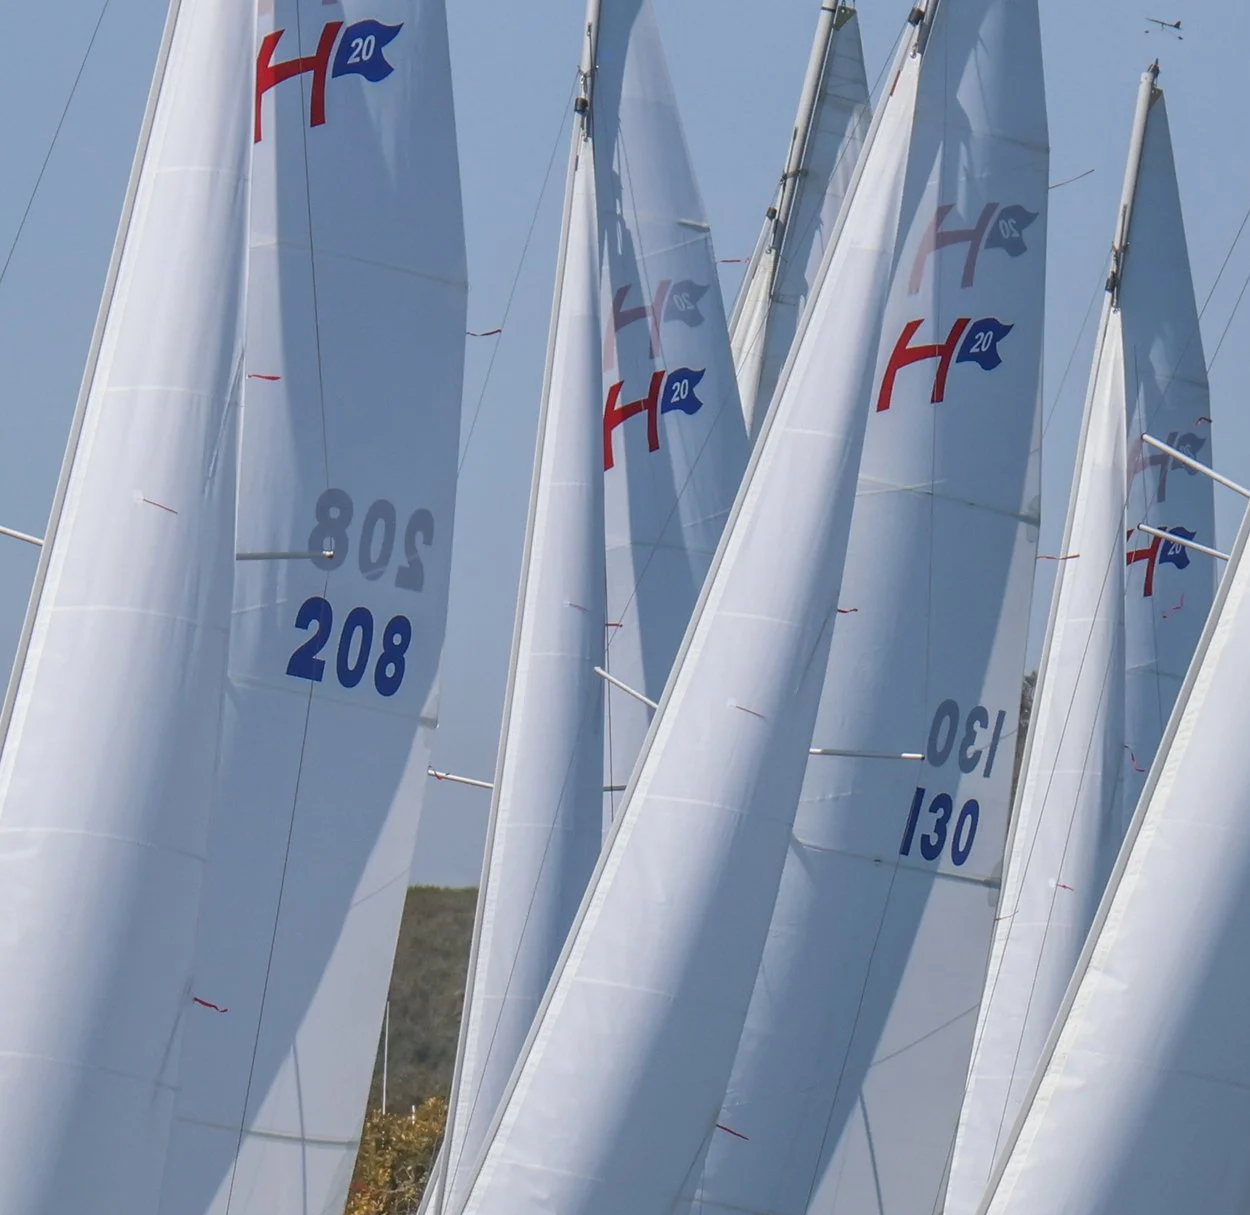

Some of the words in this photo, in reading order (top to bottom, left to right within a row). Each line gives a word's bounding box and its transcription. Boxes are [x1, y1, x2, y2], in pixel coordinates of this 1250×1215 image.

[254, 21, 344, 144] H
[347, 34, 376, 64] 20
[876, 318, 972, 413] H
[969, 331, 993, 353] 20
[603, 370, 666, 472] H
[670, 379, 689, 404] 20
[286, 596, 412, 697] 208
[899, 786, 980, 867] 130
